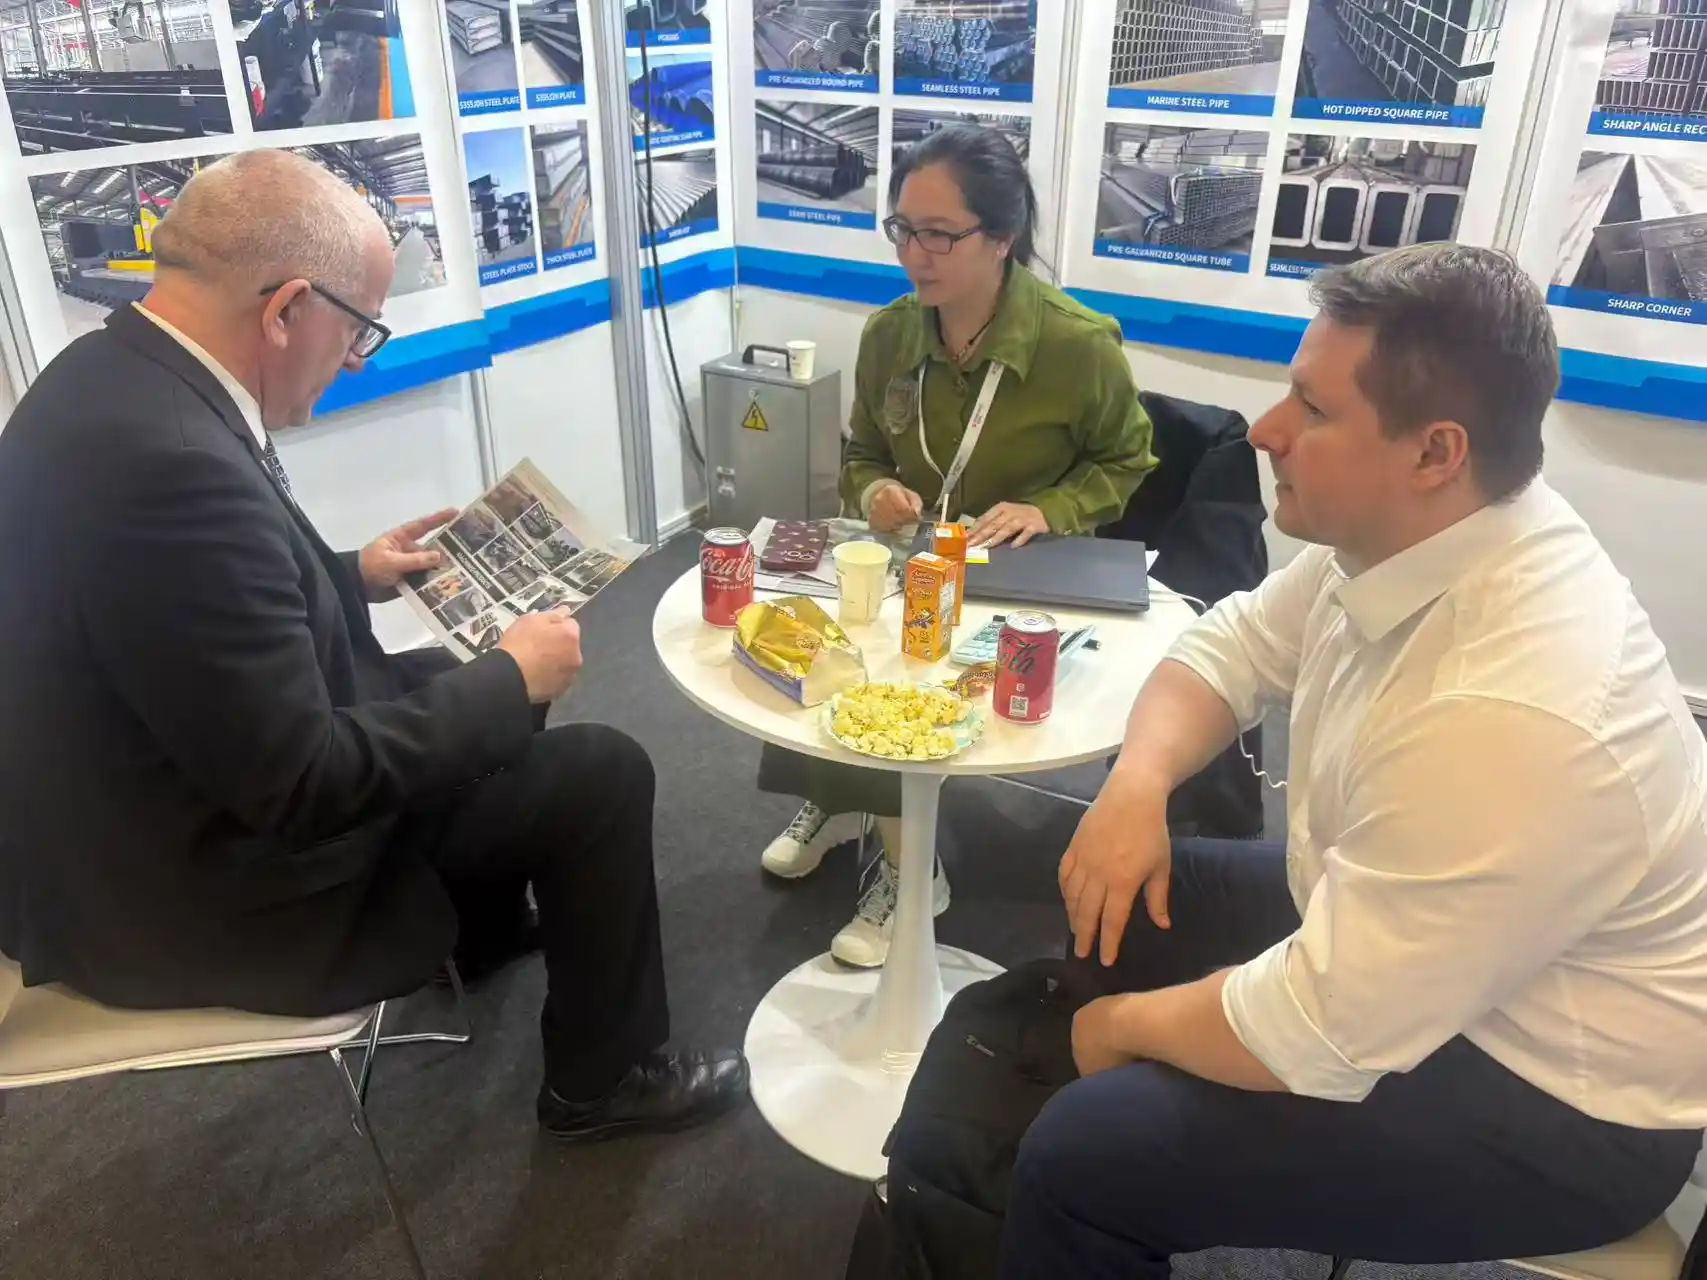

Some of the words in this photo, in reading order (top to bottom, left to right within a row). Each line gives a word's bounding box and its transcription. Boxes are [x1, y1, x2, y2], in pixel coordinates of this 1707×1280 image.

[848, 80, 864, 88] PIPE
[921, 83, 958, 94] SEAMLESS
[959, 86, 981, 95] STEEL
[982, 87, 1000, 96] PIPE
[484, 97, 502, 107] STEEL
[502, 95, 520, 105] PLATE
[1147, 95, 1180, 106] MARINE
[1180, 97, 1207, 107] STEEL
[1208, 98, 1230, 108] PIPE
[1322, 104, 1343, 114] HOT
[1344, 105, 1381, 117] DIPPED
[1383, 107, 1424, 119] SQUARE
[1425, 109, 1449, 120] PIPE
[1603, 119, 1642, 131] SHARP
[1642, 121, 1681, 133] ANGLE
[1107, 244, 1124, 254] PRE
[1124, 246, 1173, 260] GALVANIZED
[1174, 251, 1209, 264] SQUARE
[1209, 255, 1233, 266] TUBE
[482, 269, 500, 281] STEEL
[500, 265, 517, 277] PLATE
[1607, 298, 1645, 311] SHARP
[1645, 303, 1692, 317] CORNER
